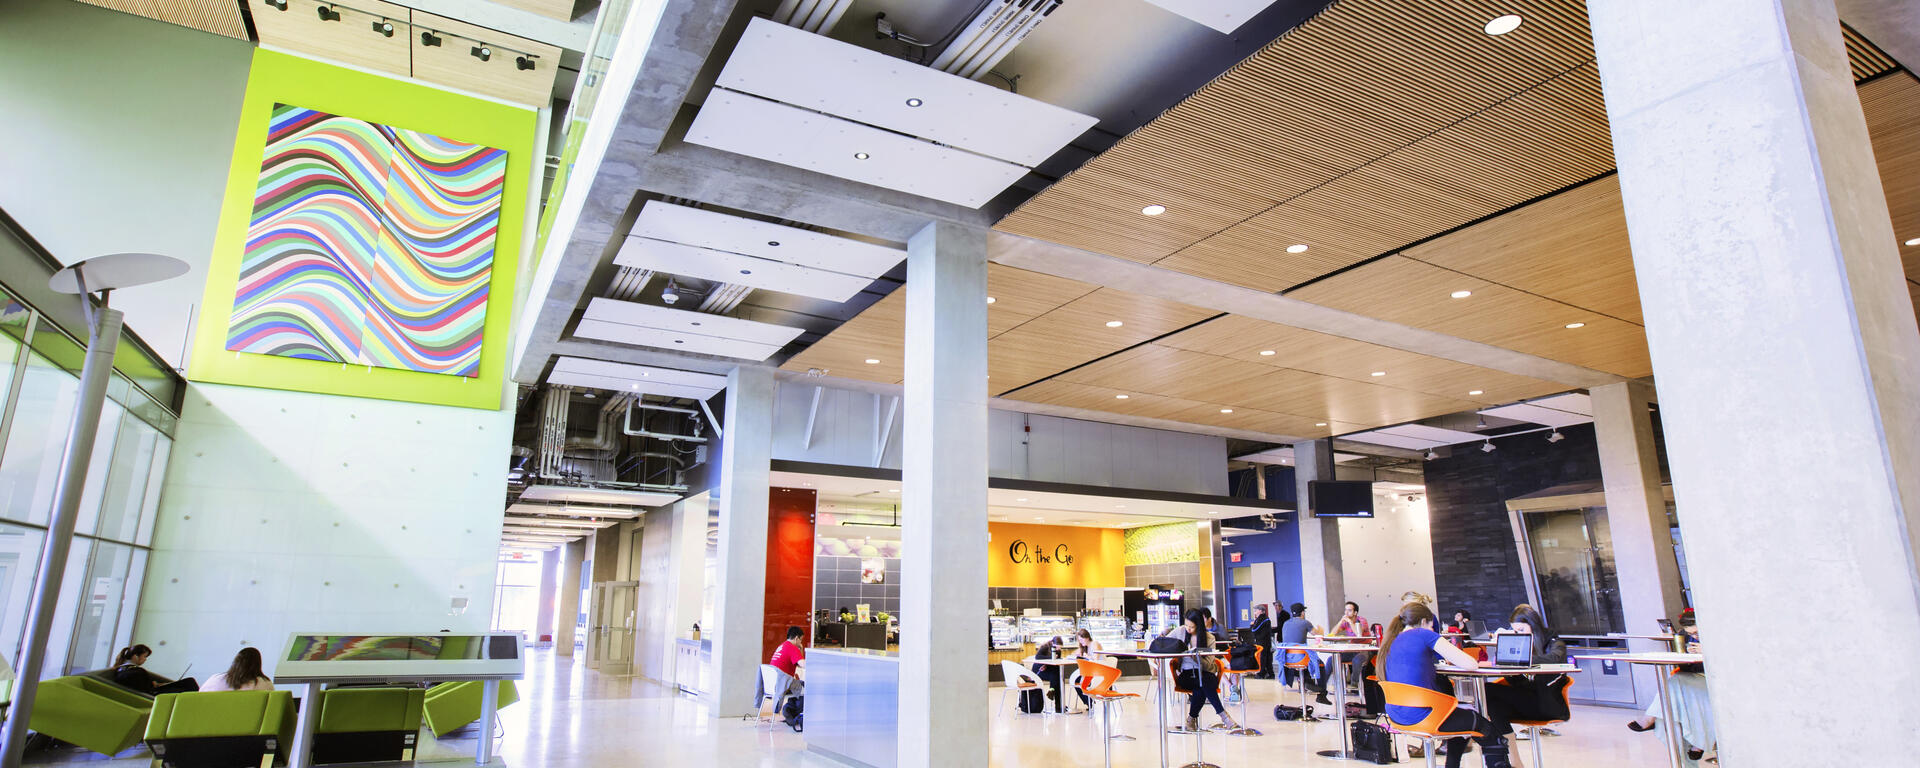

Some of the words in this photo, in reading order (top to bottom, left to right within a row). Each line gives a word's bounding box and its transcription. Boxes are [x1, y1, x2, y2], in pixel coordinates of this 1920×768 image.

[1009, 539, 1031, 564] On
[1035, 545, 1050, 564] the
[1055, 544, 1074, 566] Go
